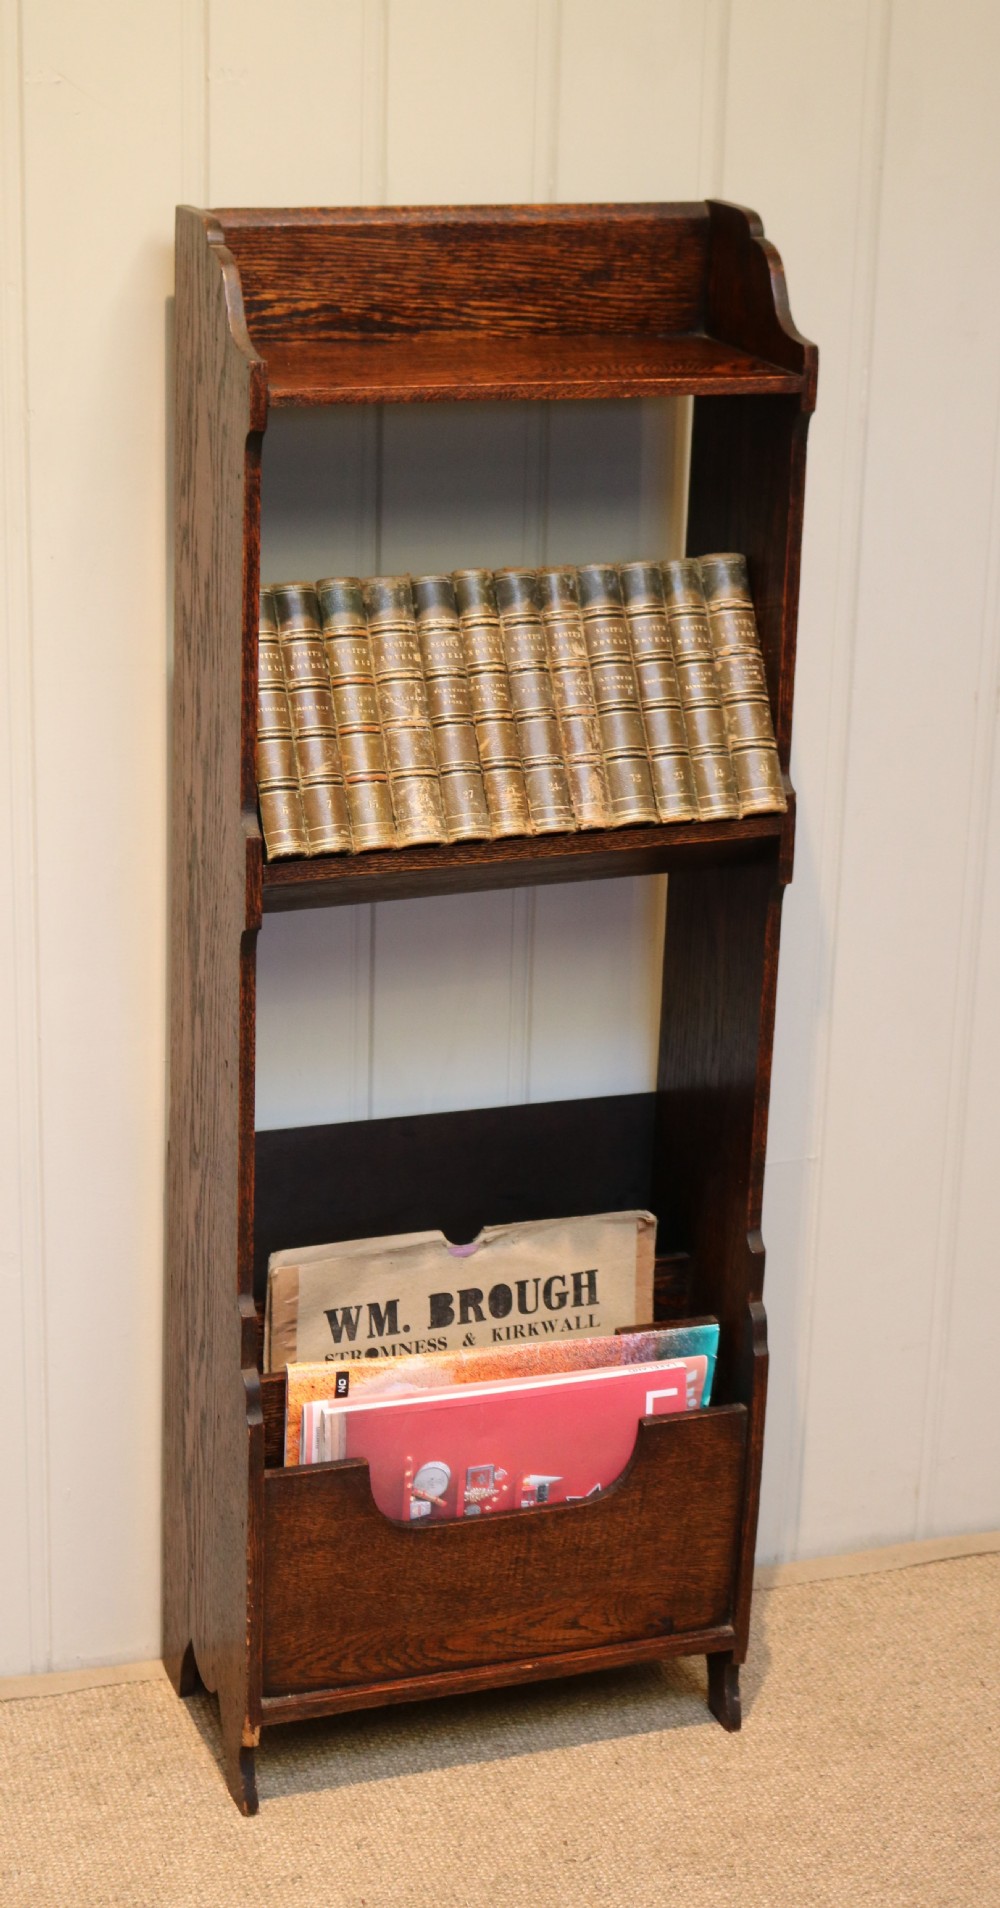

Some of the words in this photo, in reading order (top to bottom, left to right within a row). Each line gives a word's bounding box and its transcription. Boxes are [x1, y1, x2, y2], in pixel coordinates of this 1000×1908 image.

[323, 1298, 410, 1344] WM.
[427, 1268, 600, 1330] BROUGH
[324, 1336, 448, 1362] STROMNESS
[462, 1332, 476, 1347] &
[491, 1313, 601, 1343] KIRKWALL
